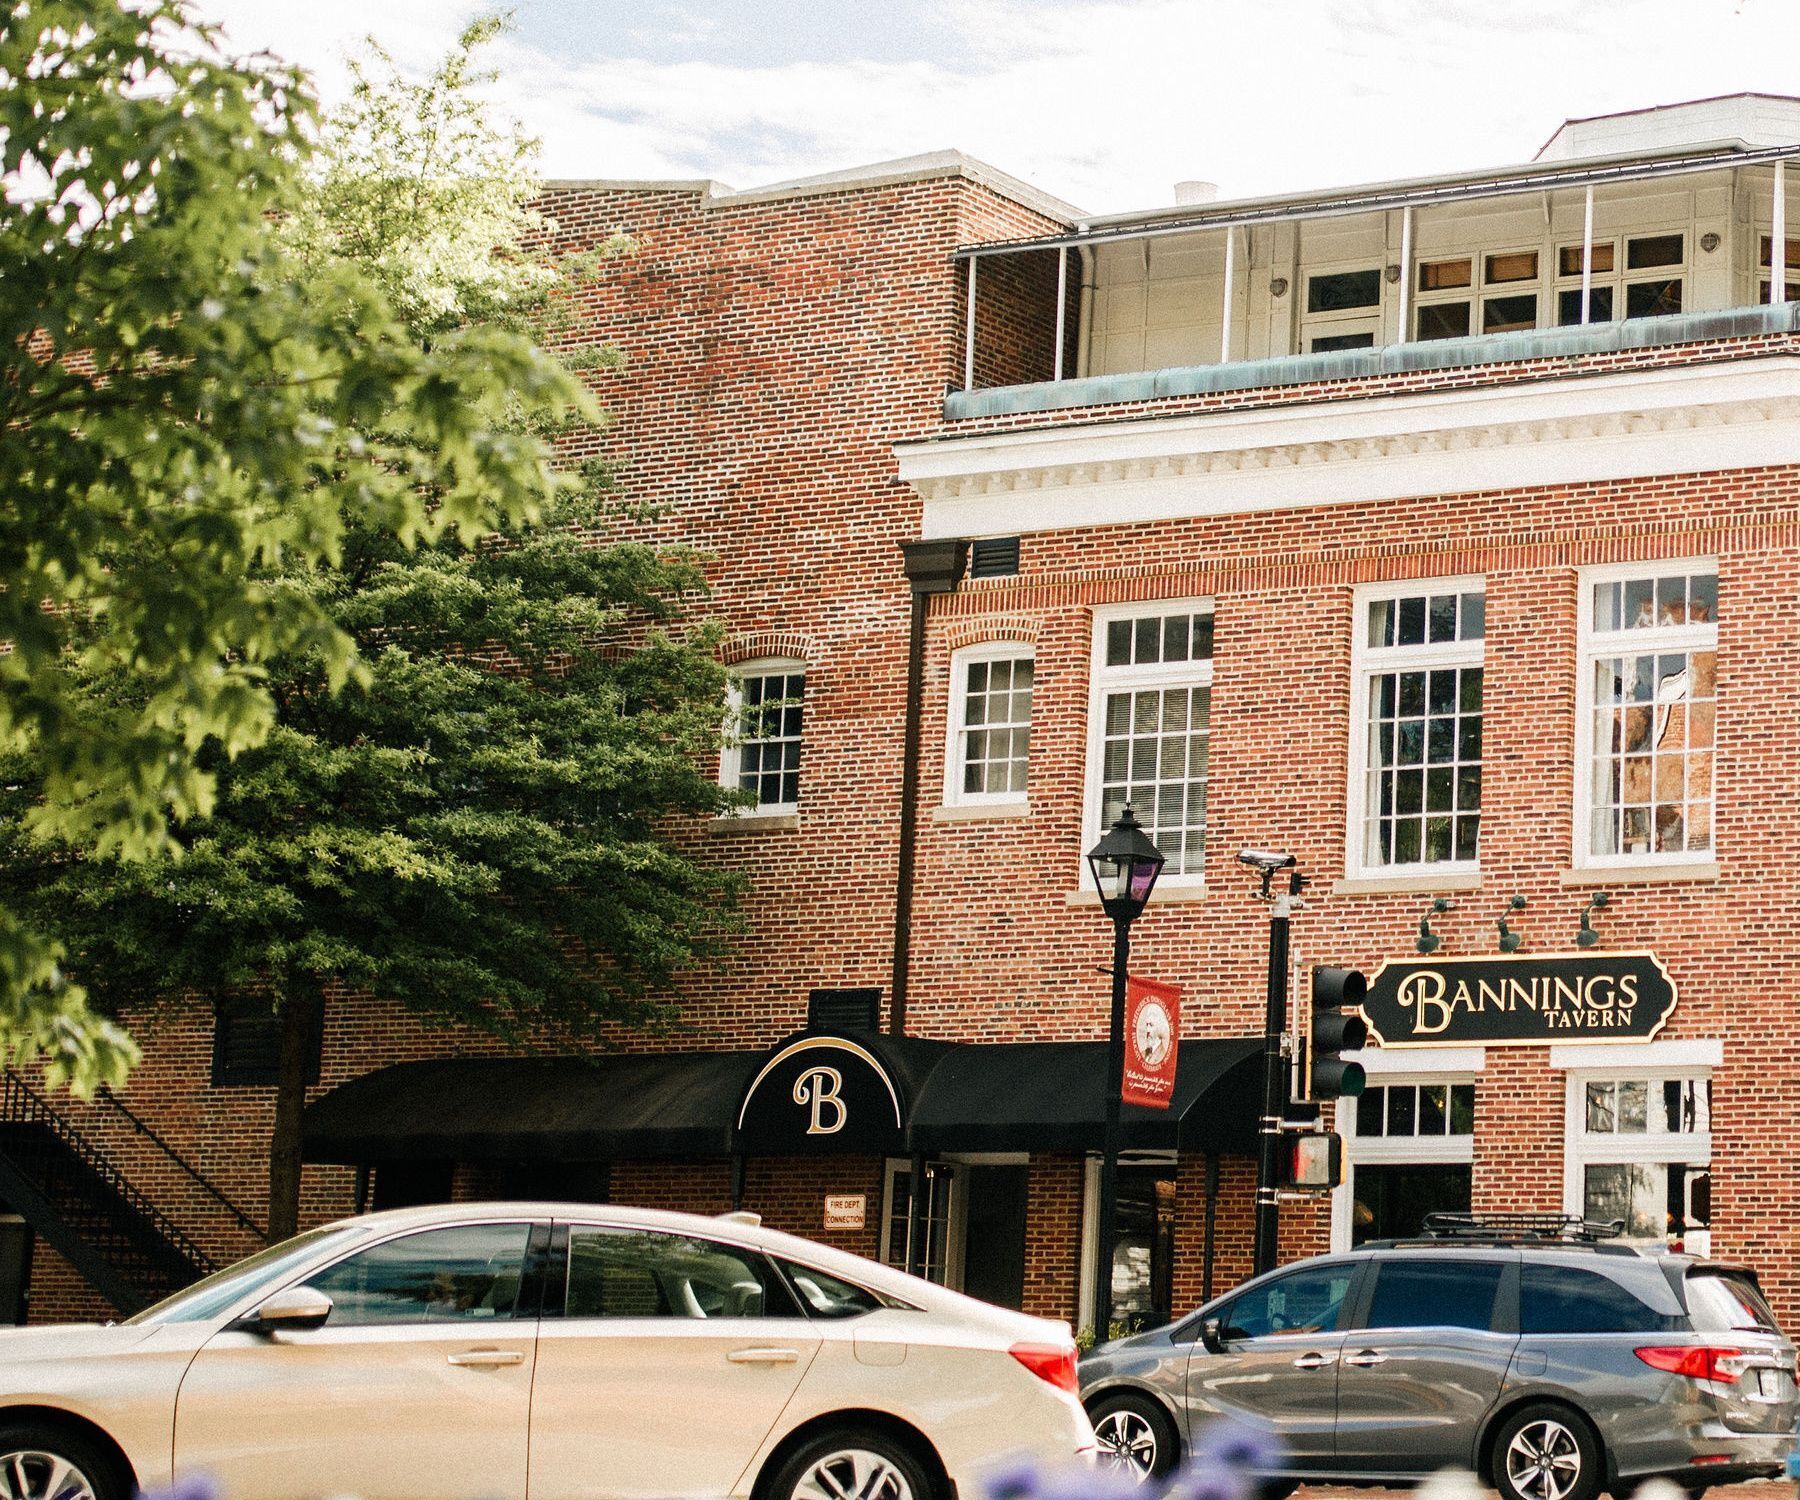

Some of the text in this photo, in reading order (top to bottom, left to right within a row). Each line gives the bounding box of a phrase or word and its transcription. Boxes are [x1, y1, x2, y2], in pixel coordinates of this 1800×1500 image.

[1396, 970, 1638, 1034] BANNINGS
[1543, 1009, 1633, 1028] TAVERN
[793, 1066, 848, 1135] B
[830, 1200, 843, 1209] FIRE
[824, 1215, 864, 1224] CONNECTION
